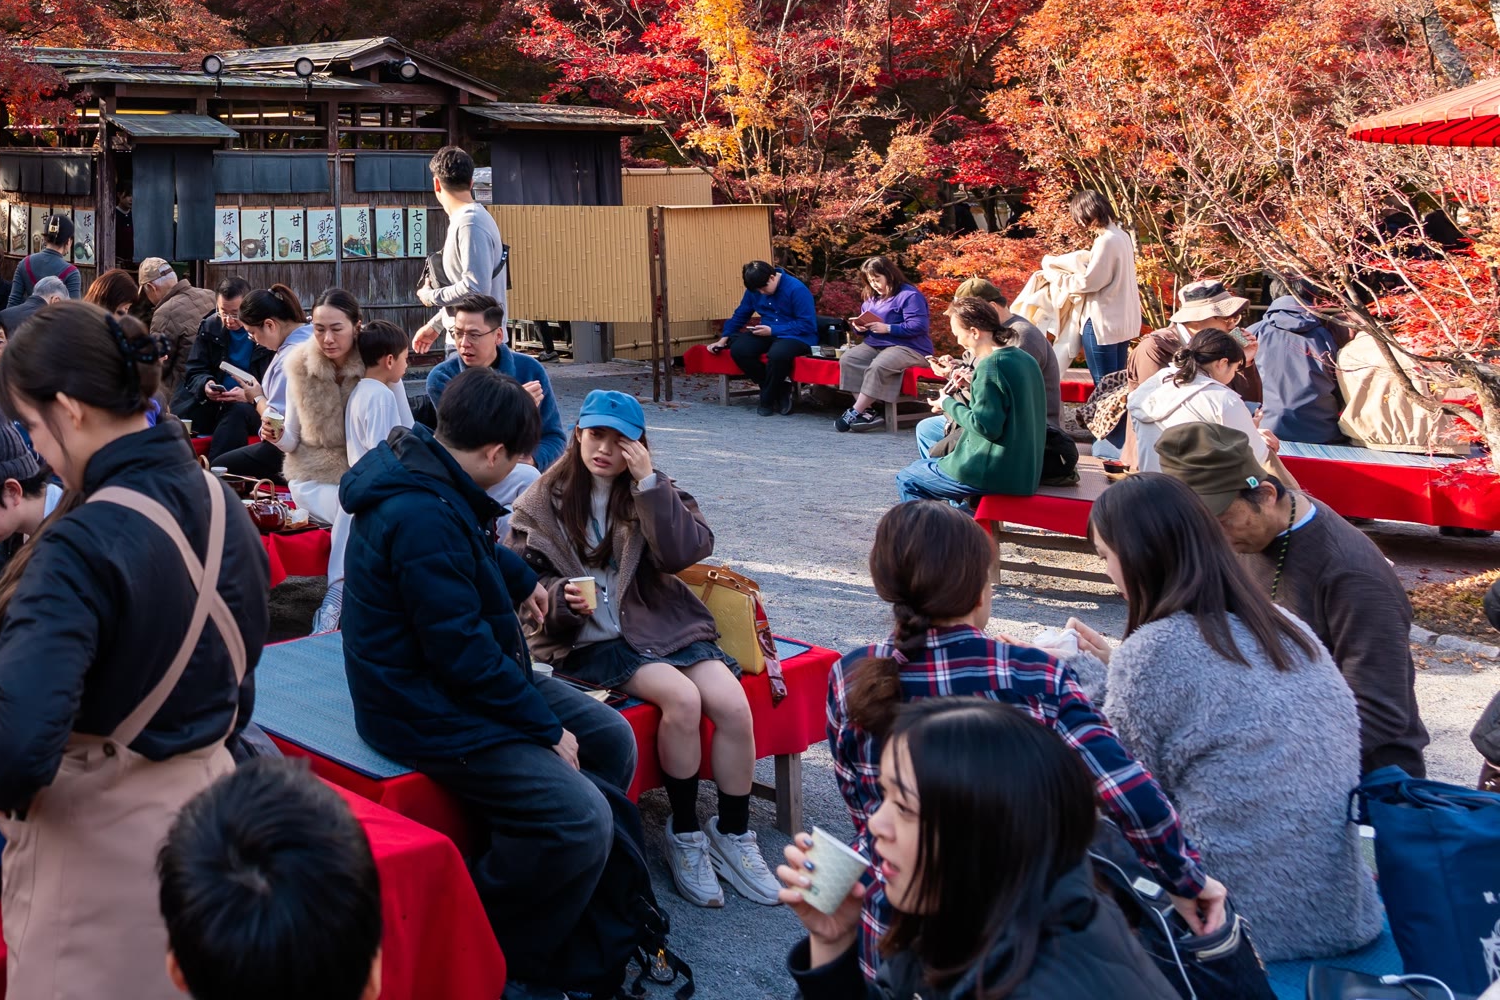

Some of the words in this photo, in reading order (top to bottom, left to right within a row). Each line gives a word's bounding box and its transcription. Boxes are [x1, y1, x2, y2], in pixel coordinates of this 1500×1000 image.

[222, 211, 235, 246] 抹茶
[257, 211, 269, 258] ぜんざい
[289, 213, 302, 253] 甘酒
